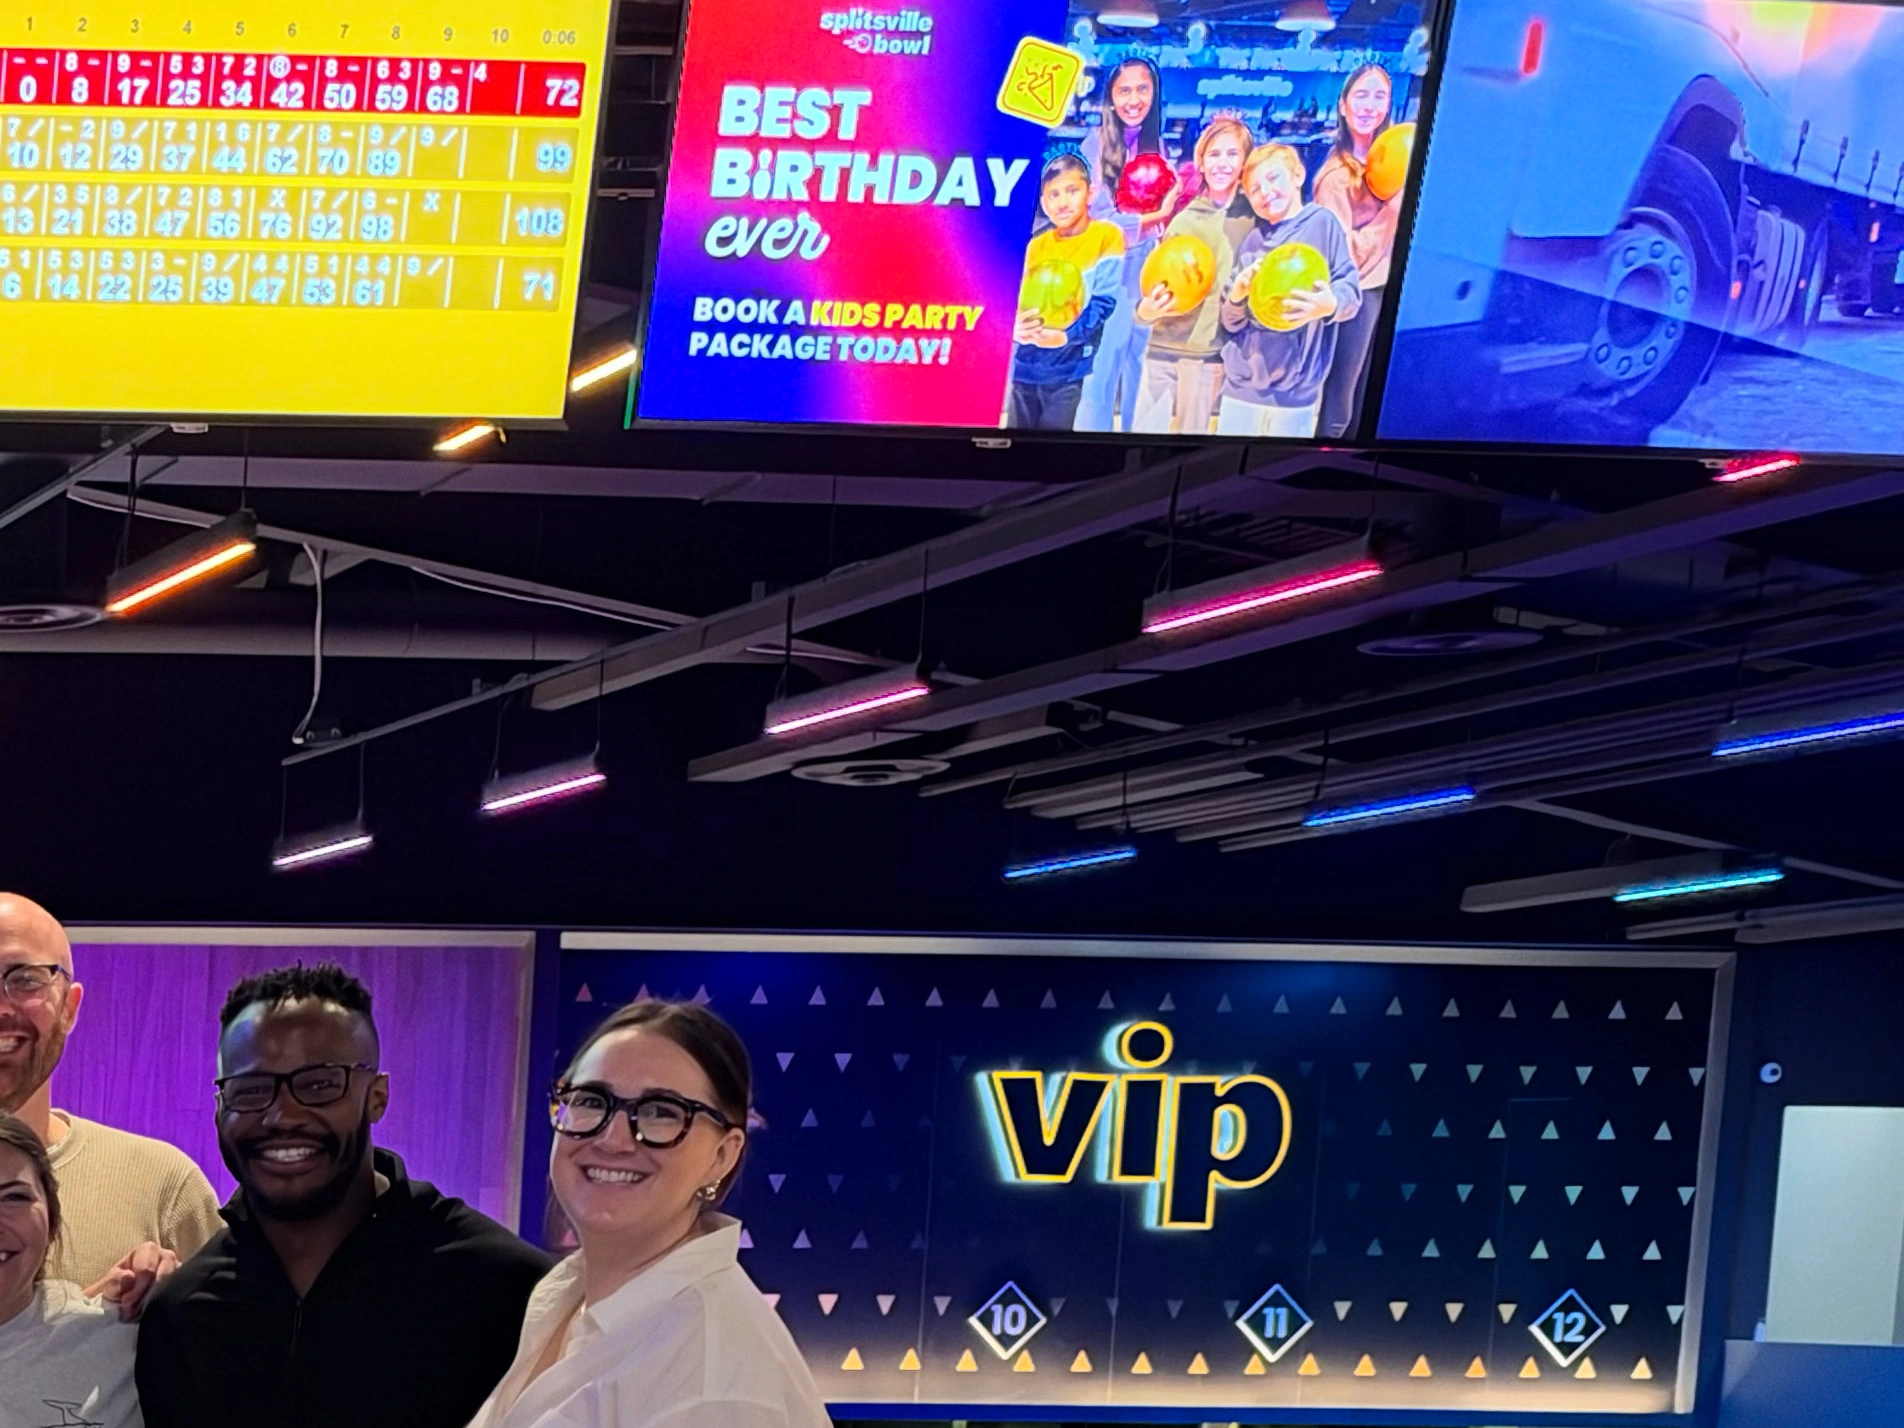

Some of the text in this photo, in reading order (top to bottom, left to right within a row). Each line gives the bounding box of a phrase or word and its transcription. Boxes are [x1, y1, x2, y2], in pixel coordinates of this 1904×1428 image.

[542, 30, 576, 45] 0:06
[820, 9, 933, 34] splitsville
[873, 31, 931, 55] bowl
[20, 76, 36, 102] 0
[72, 77, 88, 103] 8
[118, 78, 150, 104] 17
[167, 79, 201, 106] 25
[220, 80, 252, 107] 34
[271, 82, 304, 108] 42
[324, 83, 356, 110] 50
[375, 84, 408, 111] 59
[426, 85, 459, 112] 68
[546, 78, 580, 106] 72
[718, 85, 872, 139] BEST
[536, 144, 571, 171] 99
[516, 208, 564, 236] 108
[704, 211, 831, 261] ever
[523, 274, 556, 301] 71
[693, 298, 984, 331] BOOK A KIDS PARTY
[688, 331, 951, 364] PACKAGE TODAY!
[978, 1020, 1292, 1231] vip
[990, 1303, 1028, 1337] 10
[1262, 1308, 1289, 1338] 11
[1552, 1312, 1587, 1344] 12
